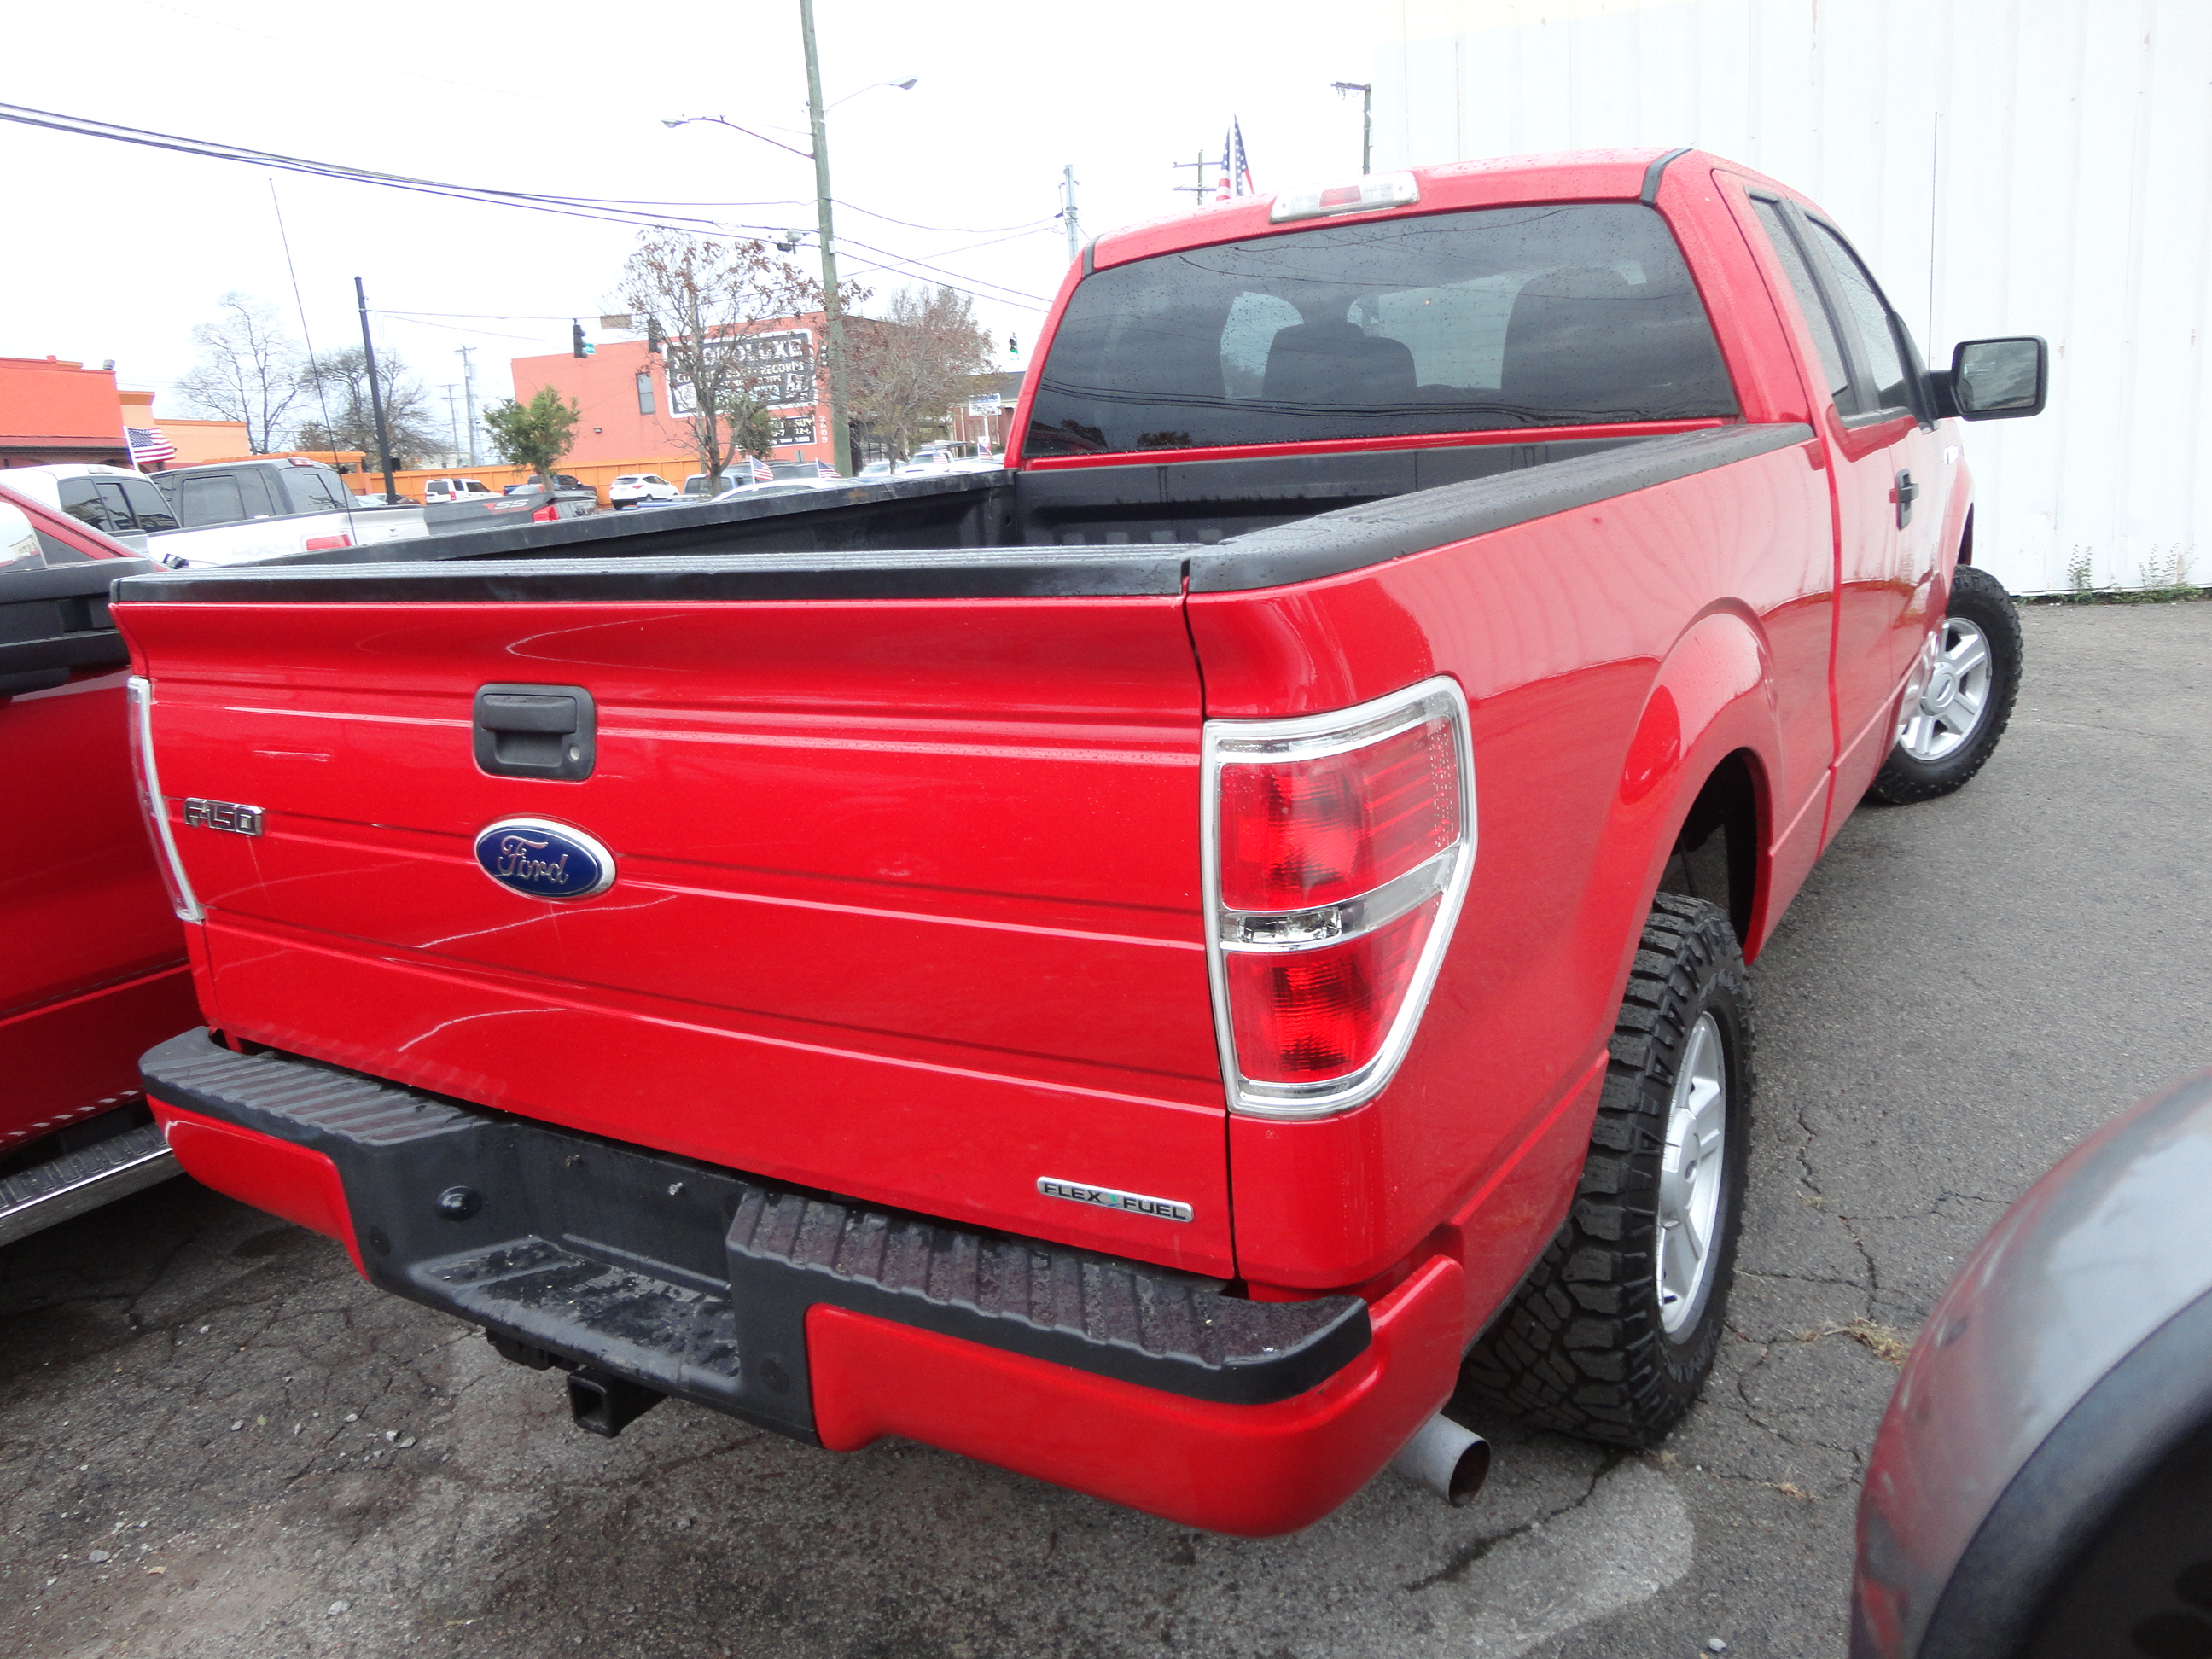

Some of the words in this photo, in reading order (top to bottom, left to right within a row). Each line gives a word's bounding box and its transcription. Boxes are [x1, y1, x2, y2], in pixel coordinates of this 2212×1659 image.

[760, 361, 805, 375] RECORDS
[819, 415, 829, 443] 2609
[493, 498, 529, 509] SS
[493, 835, 569, 884] Ford
[1044, 1183, 1103, 1203] FLEX
[1123, 1196, 1186, 1220] FUEL
